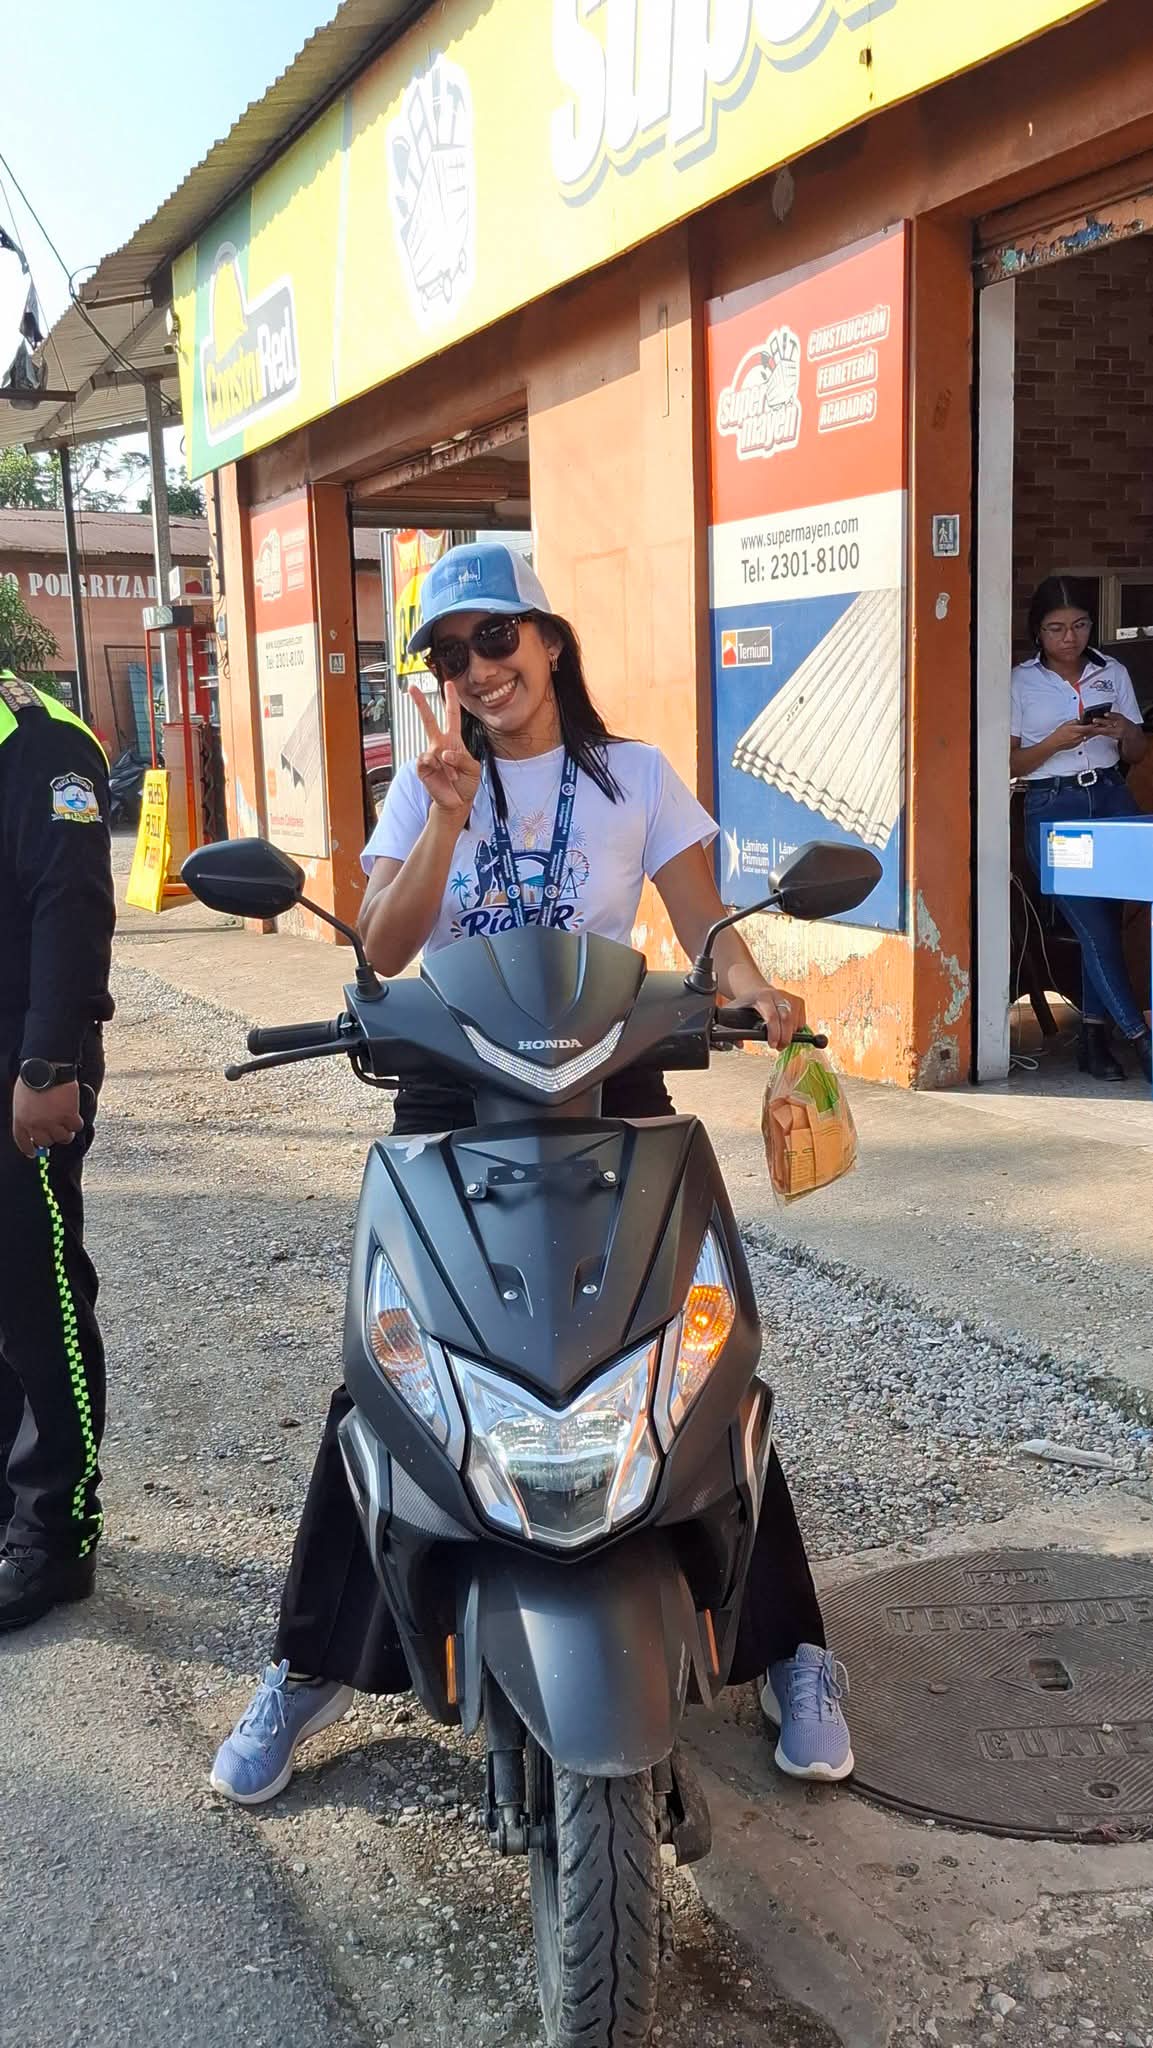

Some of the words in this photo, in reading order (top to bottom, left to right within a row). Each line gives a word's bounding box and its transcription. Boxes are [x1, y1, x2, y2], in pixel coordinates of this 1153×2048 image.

[820, 394, 874, 429] ACABADOS
[740, 516, 859, 550] www.supermayen.com
[741, 557, 765, 584] Tel:
[770, 542, 860, 580] 2301-8100
[738, 642, 769, 660] Ternium
[742, 838, 769, 853] Láminas
[518, 1038, 583, 1050] HONDA
